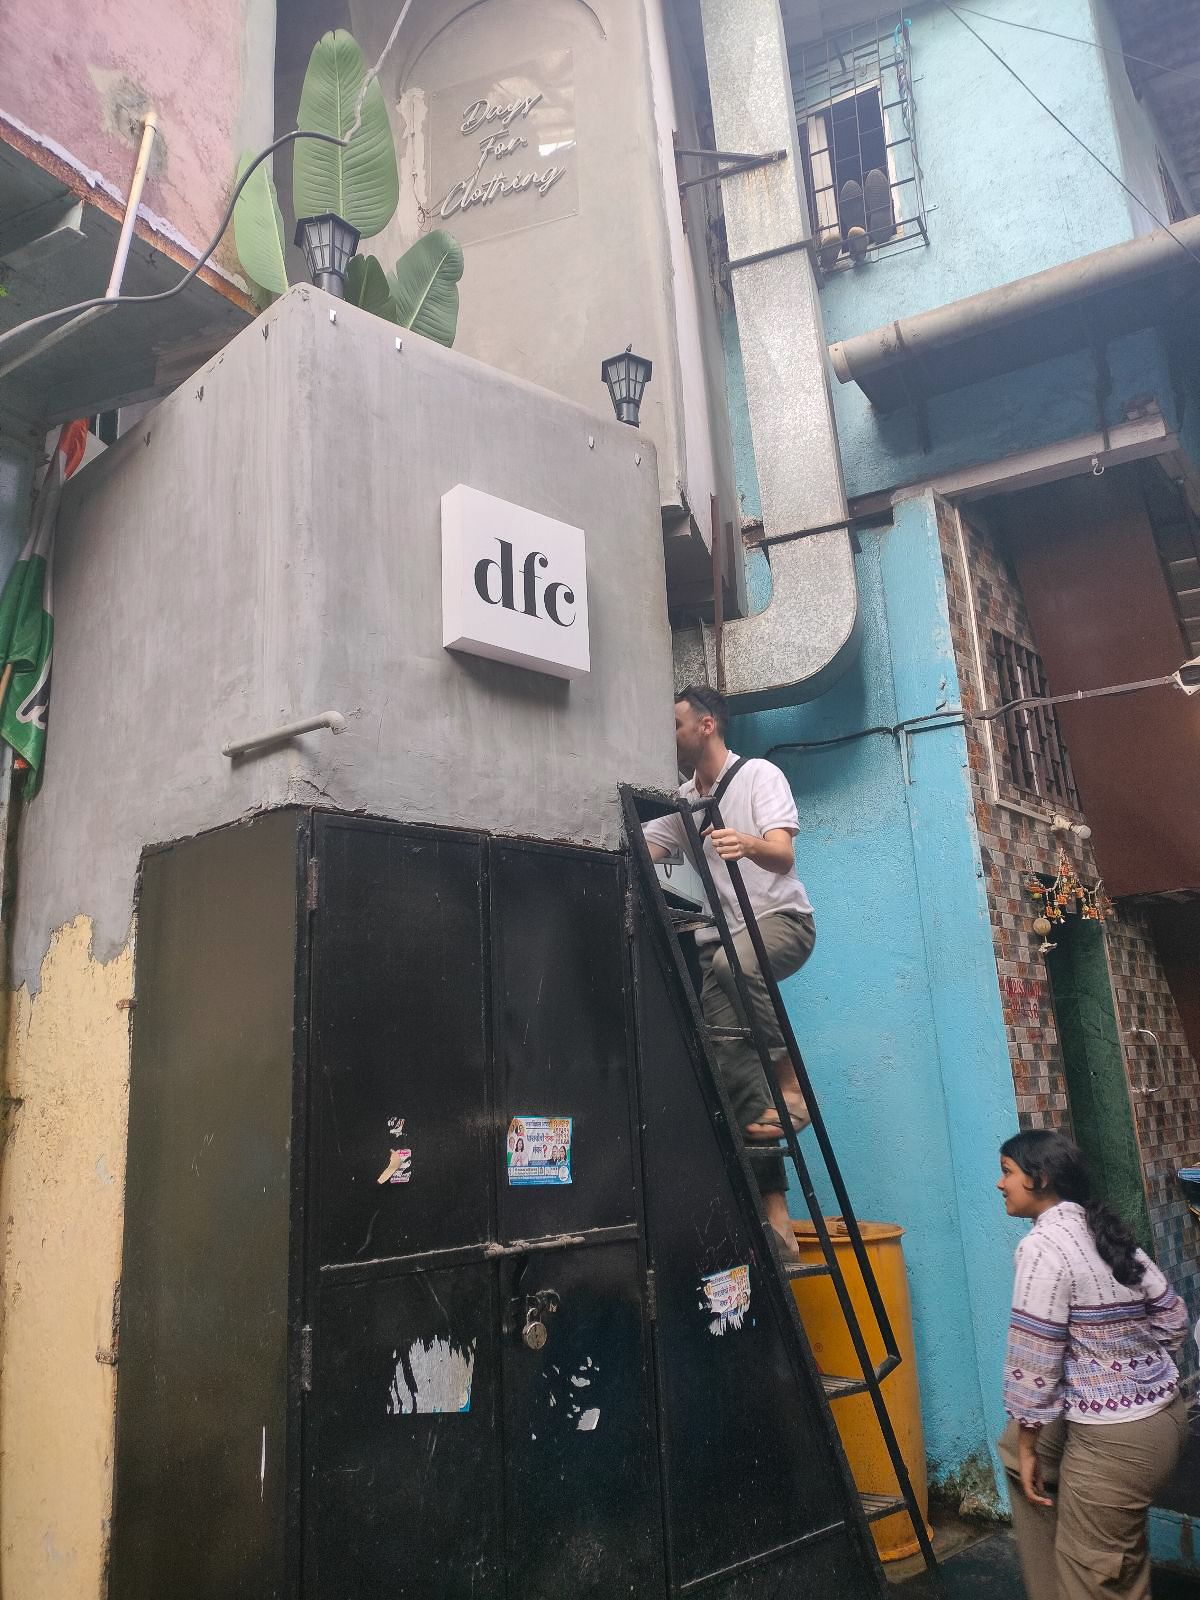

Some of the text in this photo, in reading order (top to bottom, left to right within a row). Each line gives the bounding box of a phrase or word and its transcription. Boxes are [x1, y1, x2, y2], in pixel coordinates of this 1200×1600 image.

[461, 94, 543, 132] Days
[478, 129, 528, 168] For
[441, 165, 566, 218] Clothing
[475, 537, 576, 627] dfc
